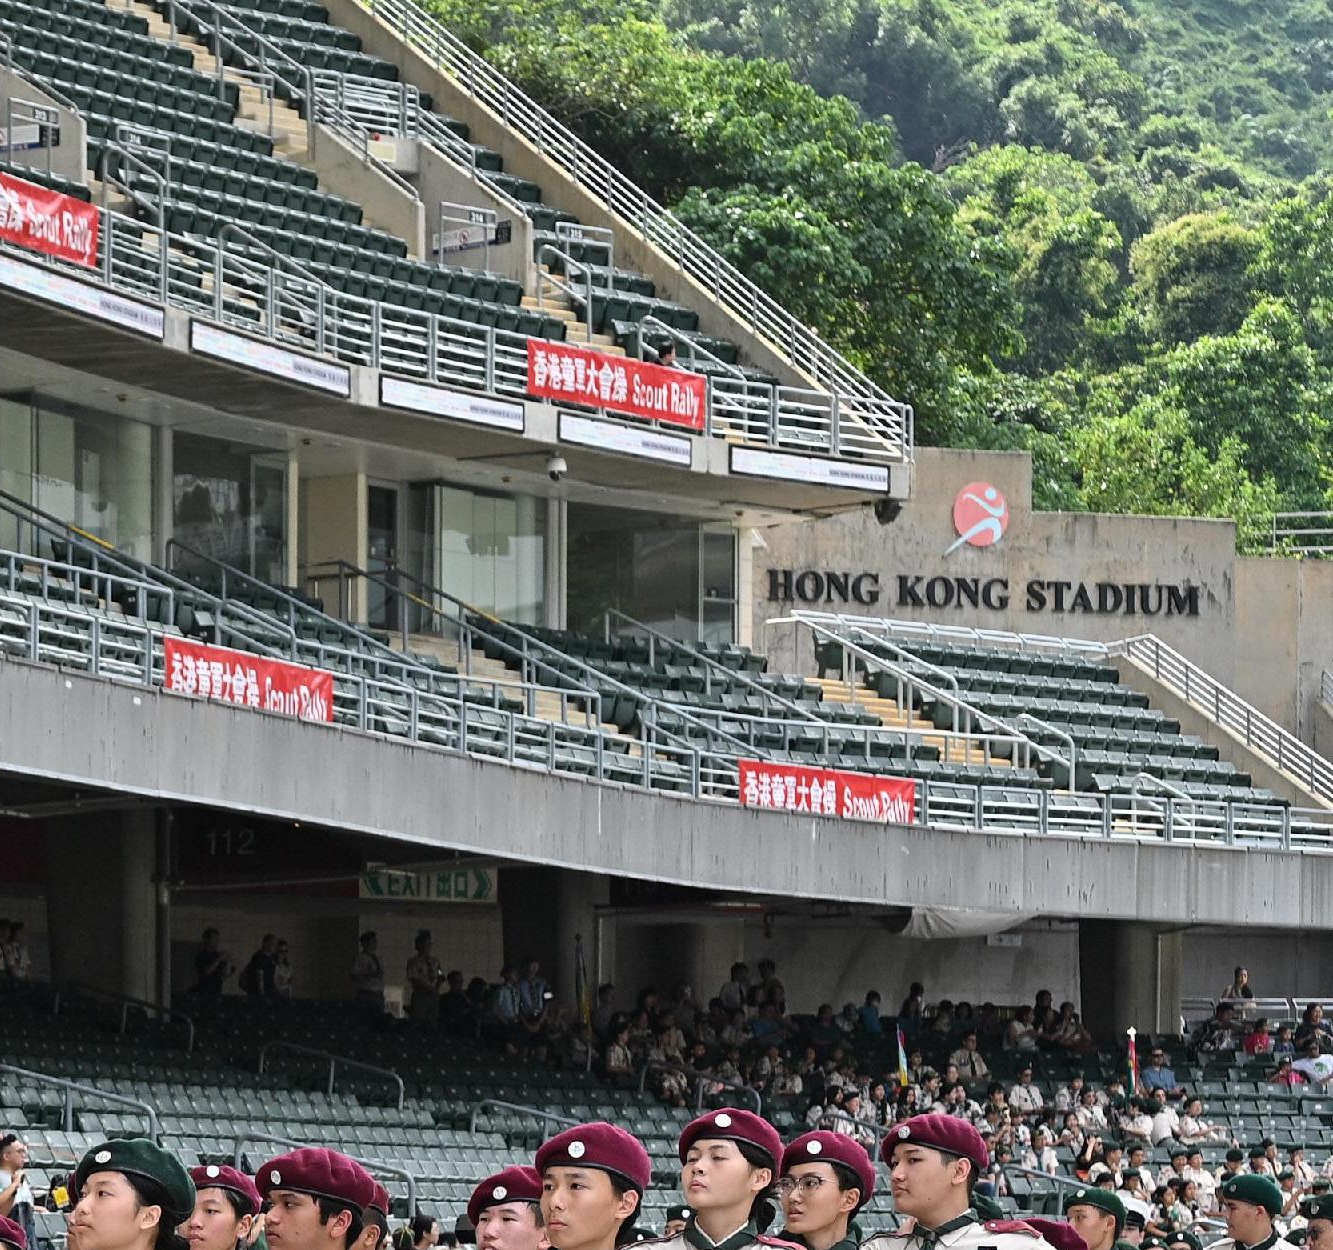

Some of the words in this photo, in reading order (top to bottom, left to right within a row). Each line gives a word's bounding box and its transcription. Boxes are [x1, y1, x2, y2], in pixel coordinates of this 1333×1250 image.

[632, 373, 669, 412] Scout
[671, 381, 701, 425] Rally
[766, 568, 880, 605] HONG
[896, 573, 1010, 610] KONG
[1025, 579, 1201, 617] STADIUM
[264, 676, 299, 715] Scout
[842, 785, 880, 819] Scout
[206, 828, 256, 856] 112
